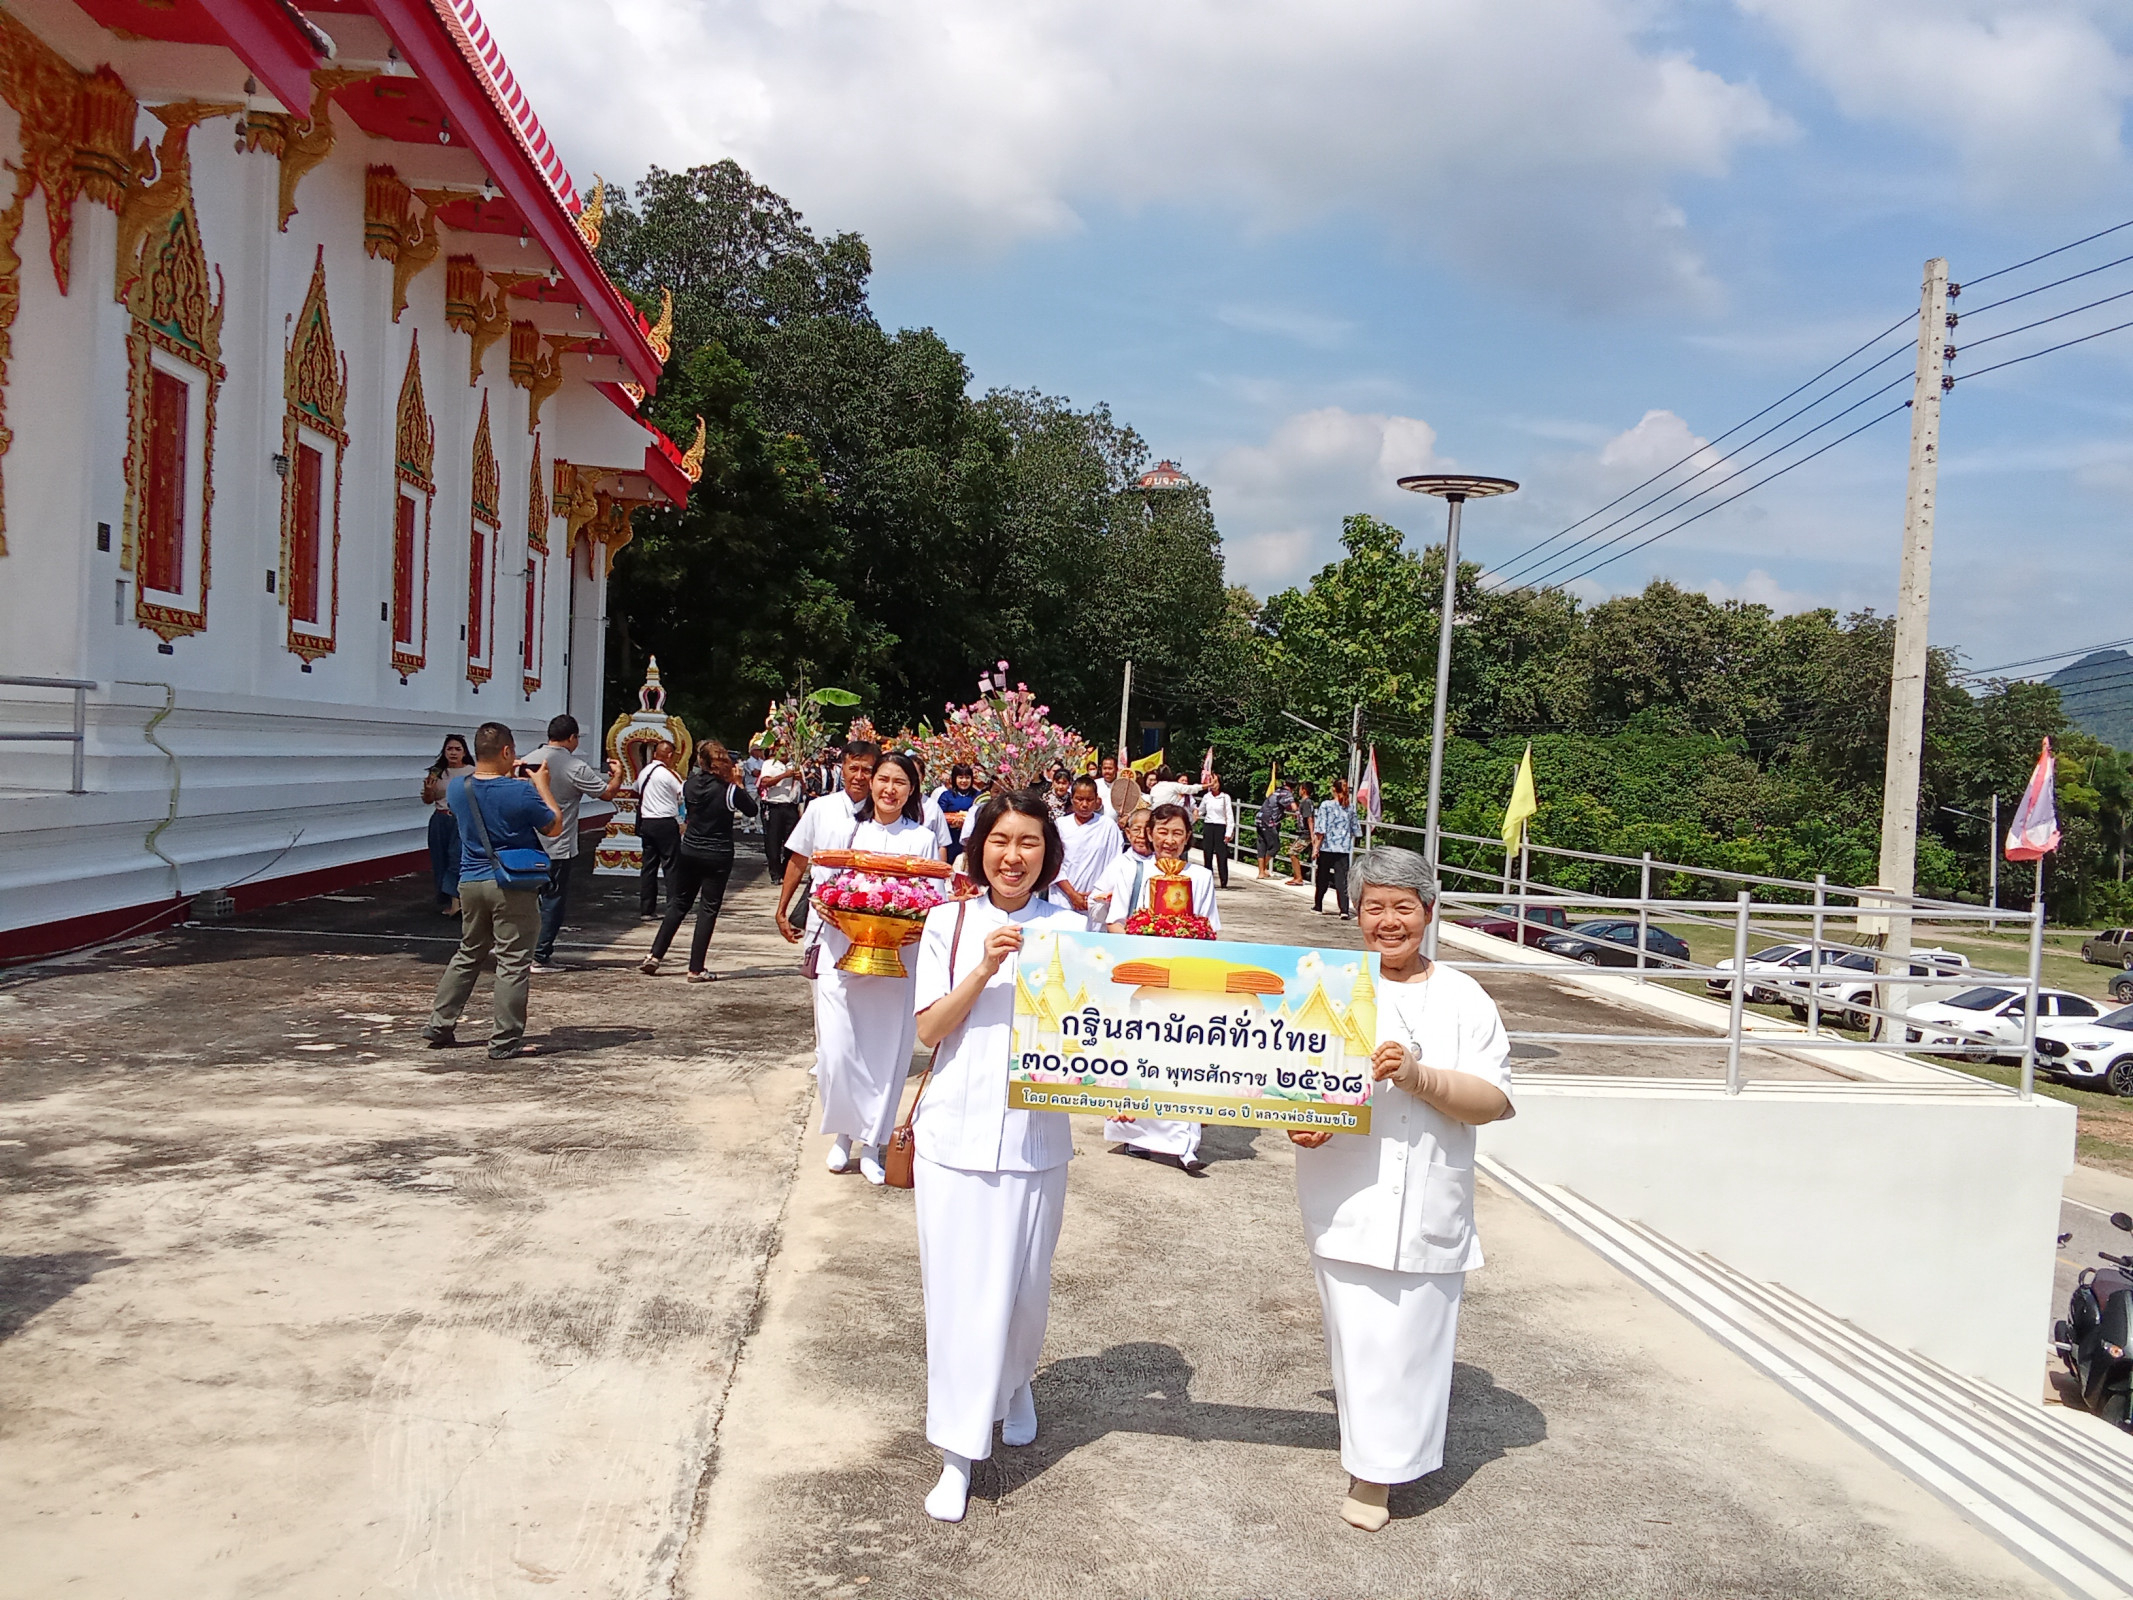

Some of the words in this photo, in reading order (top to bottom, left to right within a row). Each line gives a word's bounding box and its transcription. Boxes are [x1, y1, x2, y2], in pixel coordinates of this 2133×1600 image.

[1061, 1006, 1327, 1054] กฐินสามัคคีทั่วไทย
[1022, 1052, 1129, 1077] ๓๐,๐๐๐
[1136, 1058, 1160, 1079] วัด
[1165, 1063, 1268, 1088] พุทธศักราช
[1276, 1067, 1363, 1093] ๒๕๖๘
[1023, 1090, 1047, 1104] โดย
[1051, 1093, 1149, 1112] คณะศิษยานุศิษย์
[1154, 1102, 1214, 1116] บูชาธรรม
[1218, 1107, 1237, 1117] ๘๑
[1241, 1105, 1251, 1118] ปี
